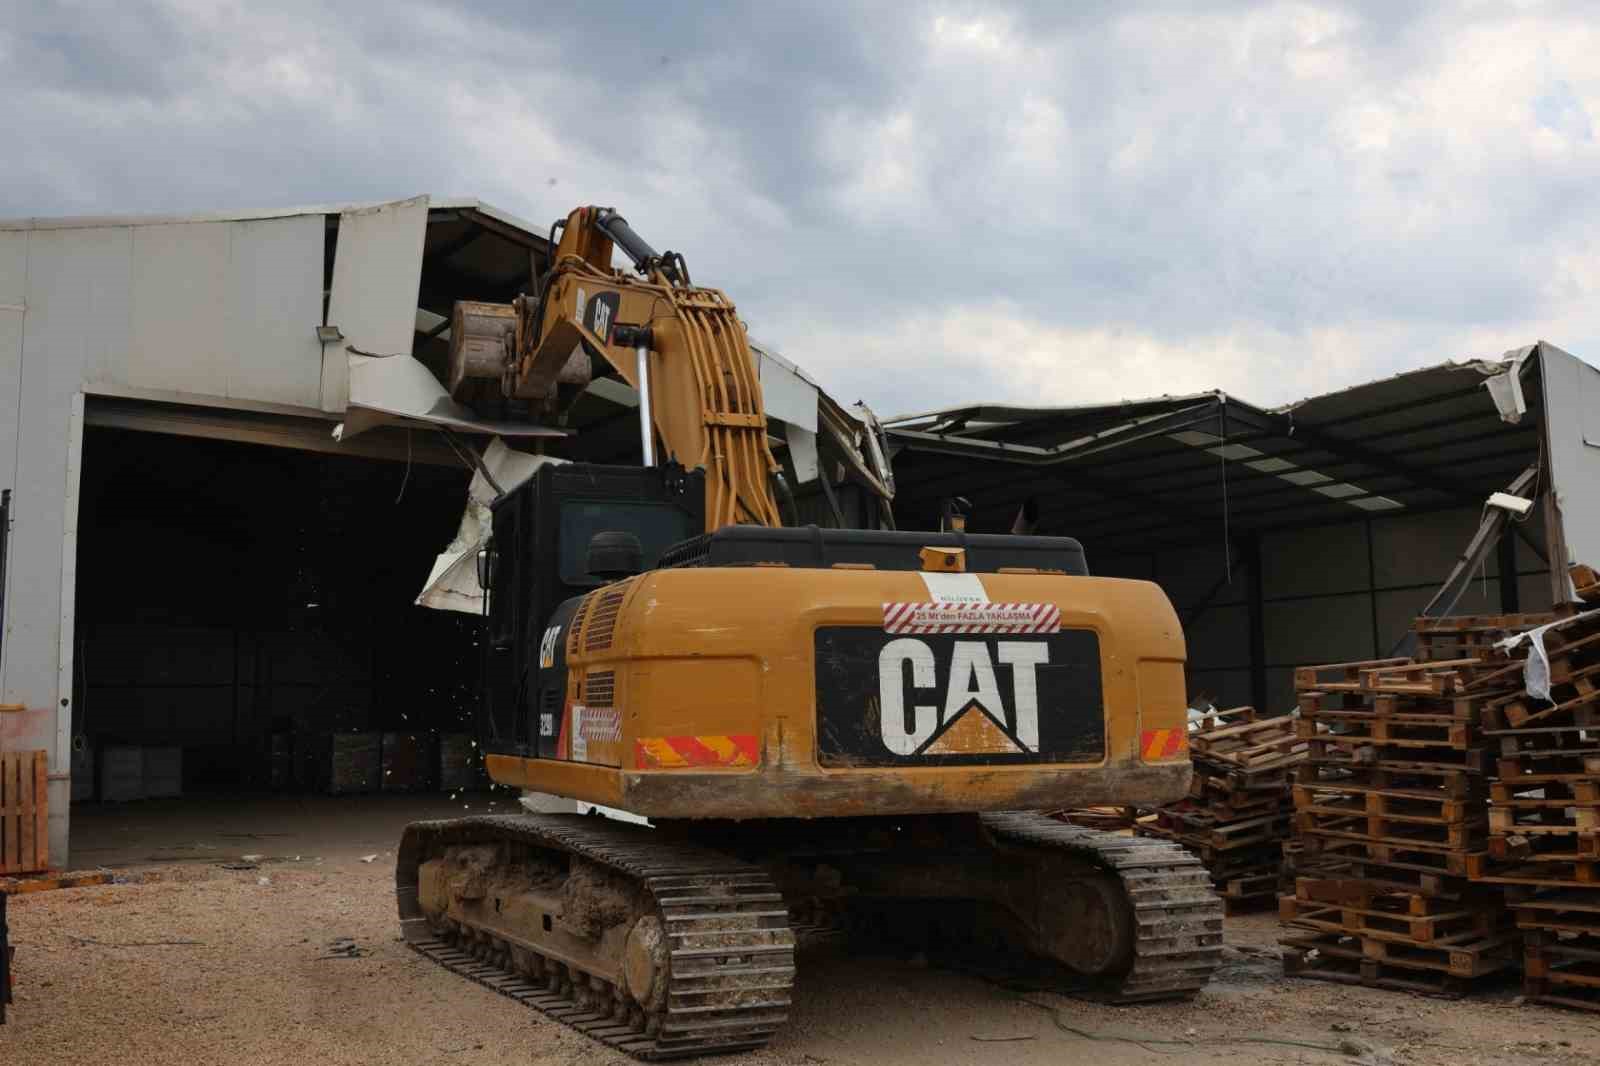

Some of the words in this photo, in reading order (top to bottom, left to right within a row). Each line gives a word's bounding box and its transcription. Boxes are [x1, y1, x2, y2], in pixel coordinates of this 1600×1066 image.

[594, 297, 609, 342] CAT
[957, 610, 984, 621] FAZLA
[540, 625, 561, 669] CAT
[879, 638, 1049, 755] CAT
